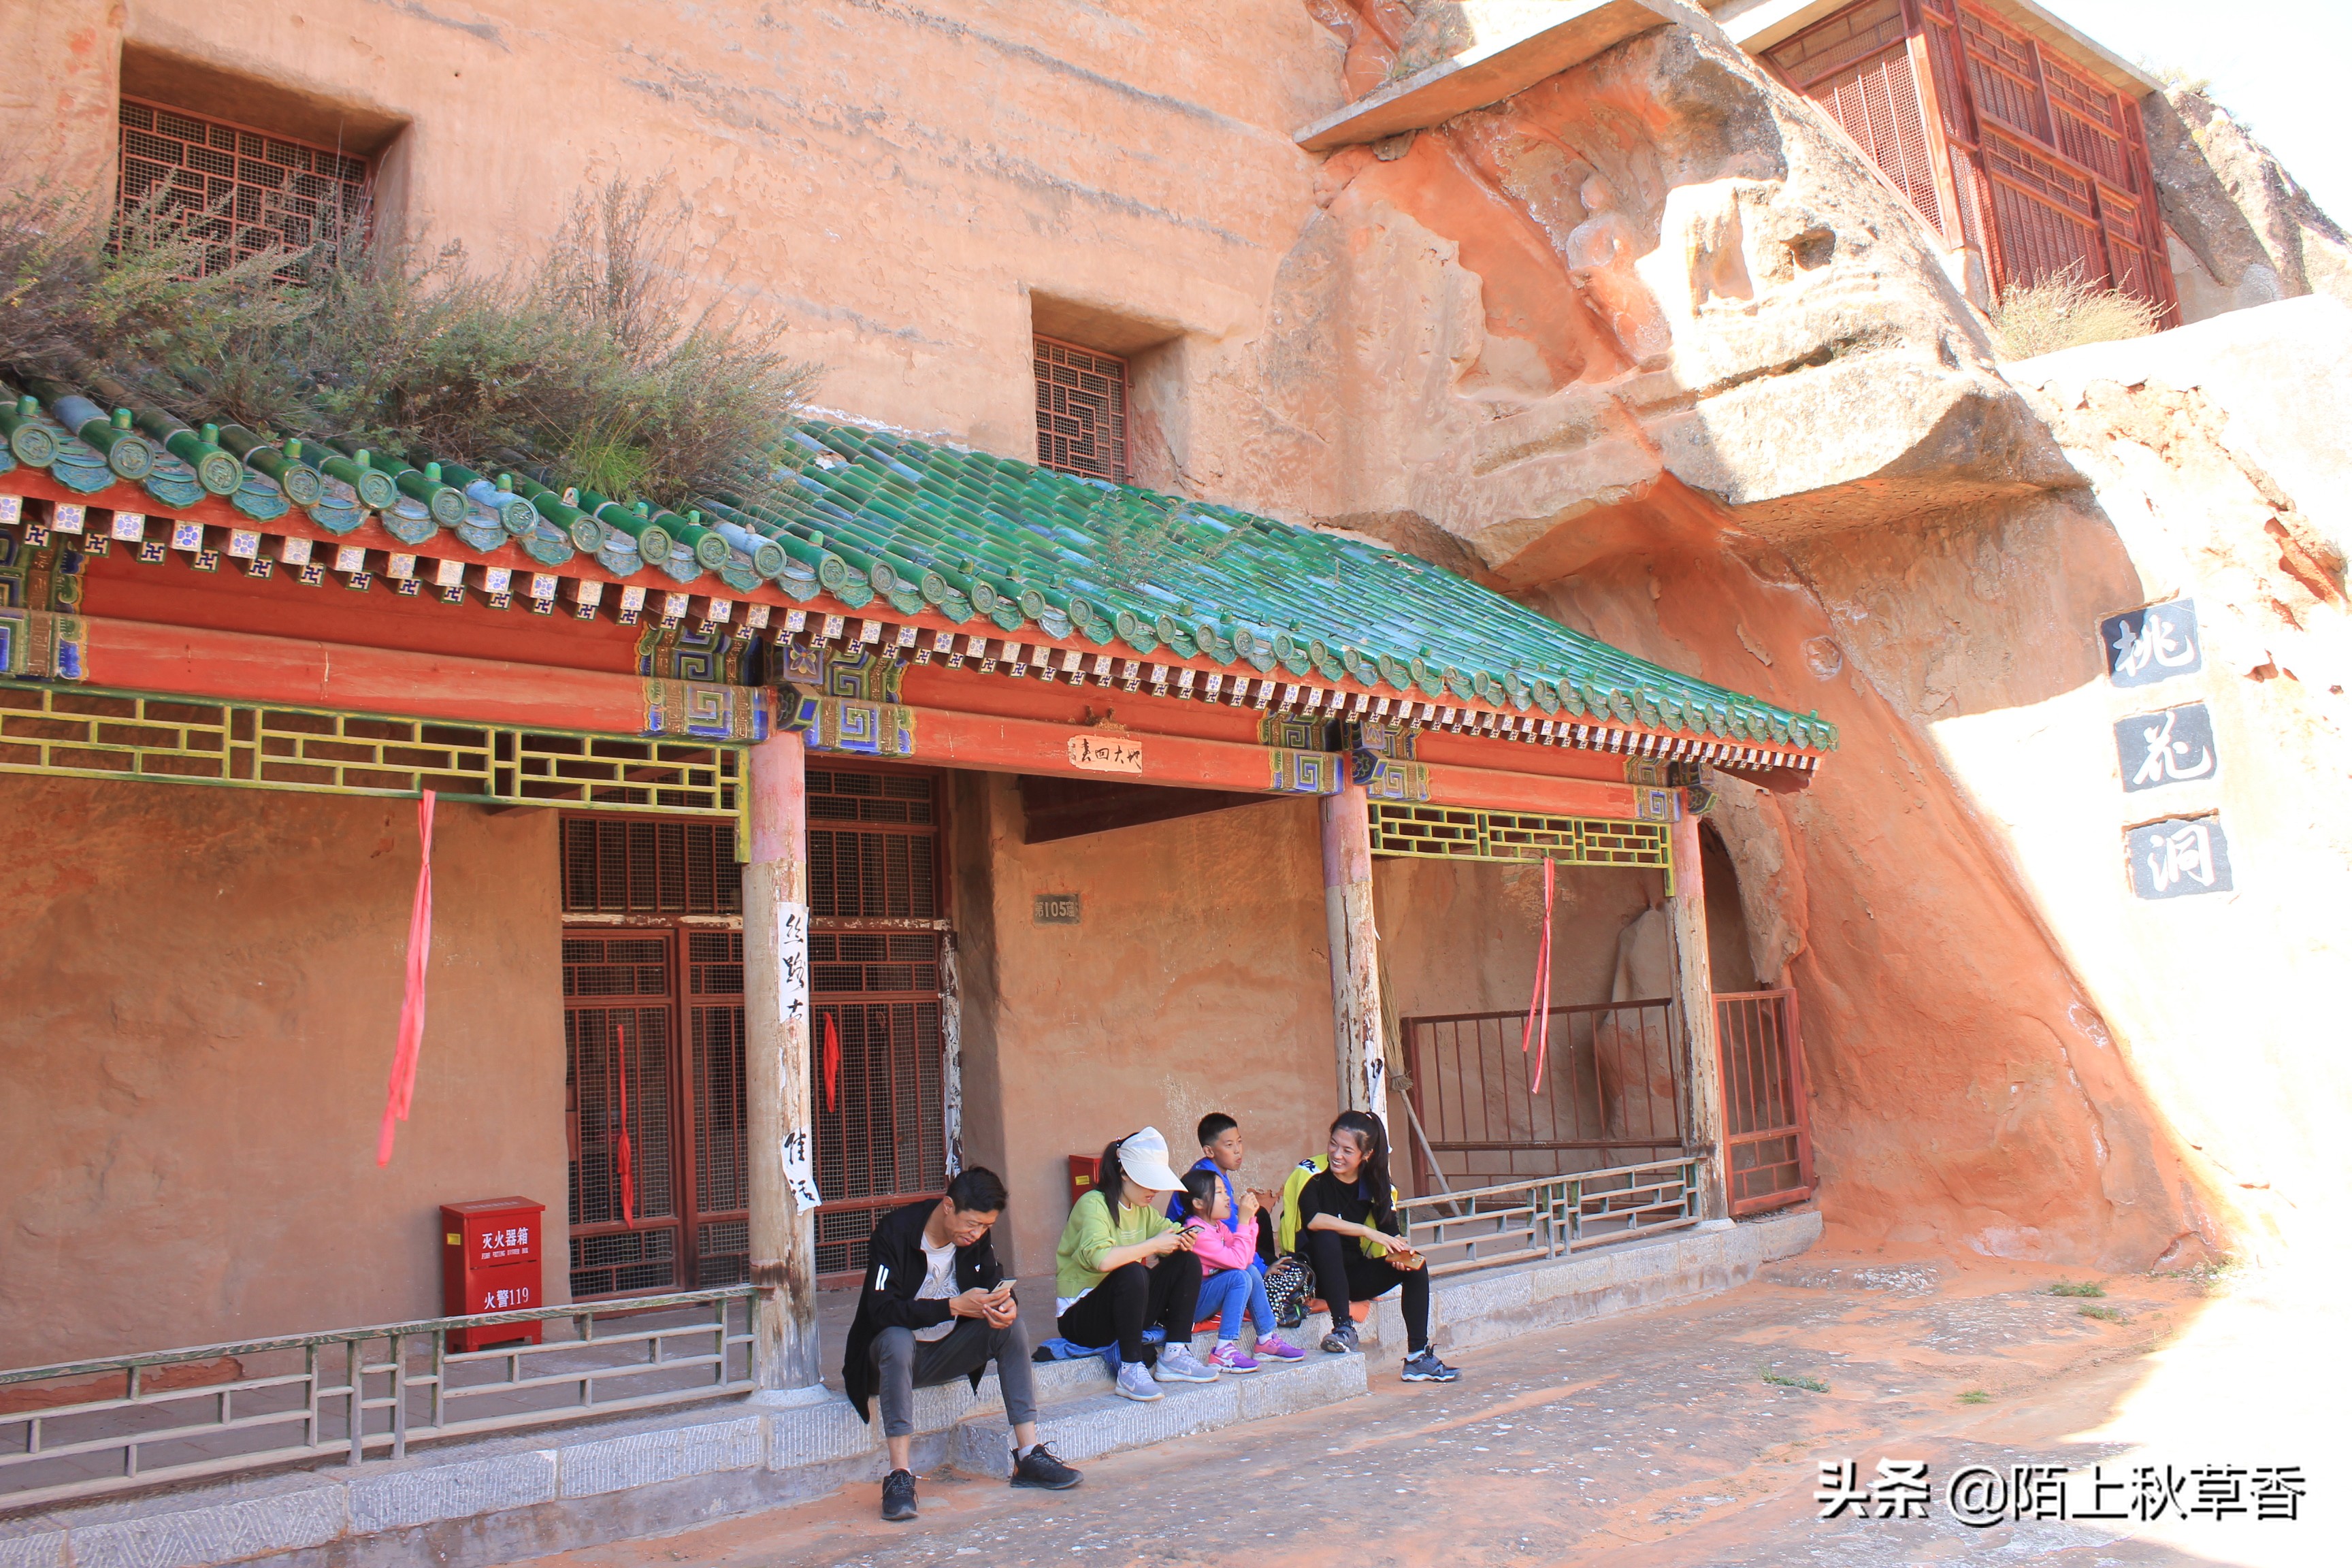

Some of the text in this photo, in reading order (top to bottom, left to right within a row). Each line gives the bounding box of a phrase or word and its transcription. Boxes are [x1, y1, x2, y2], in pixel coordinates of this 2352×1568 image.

[2112, 614, 2217, 893] 桃花洞
[1035, 900, 1075, 918] 第105窟
[482, 1227, 529, 1250] 灭火器箱
[484, 1287, 529, 1310] 火警119
